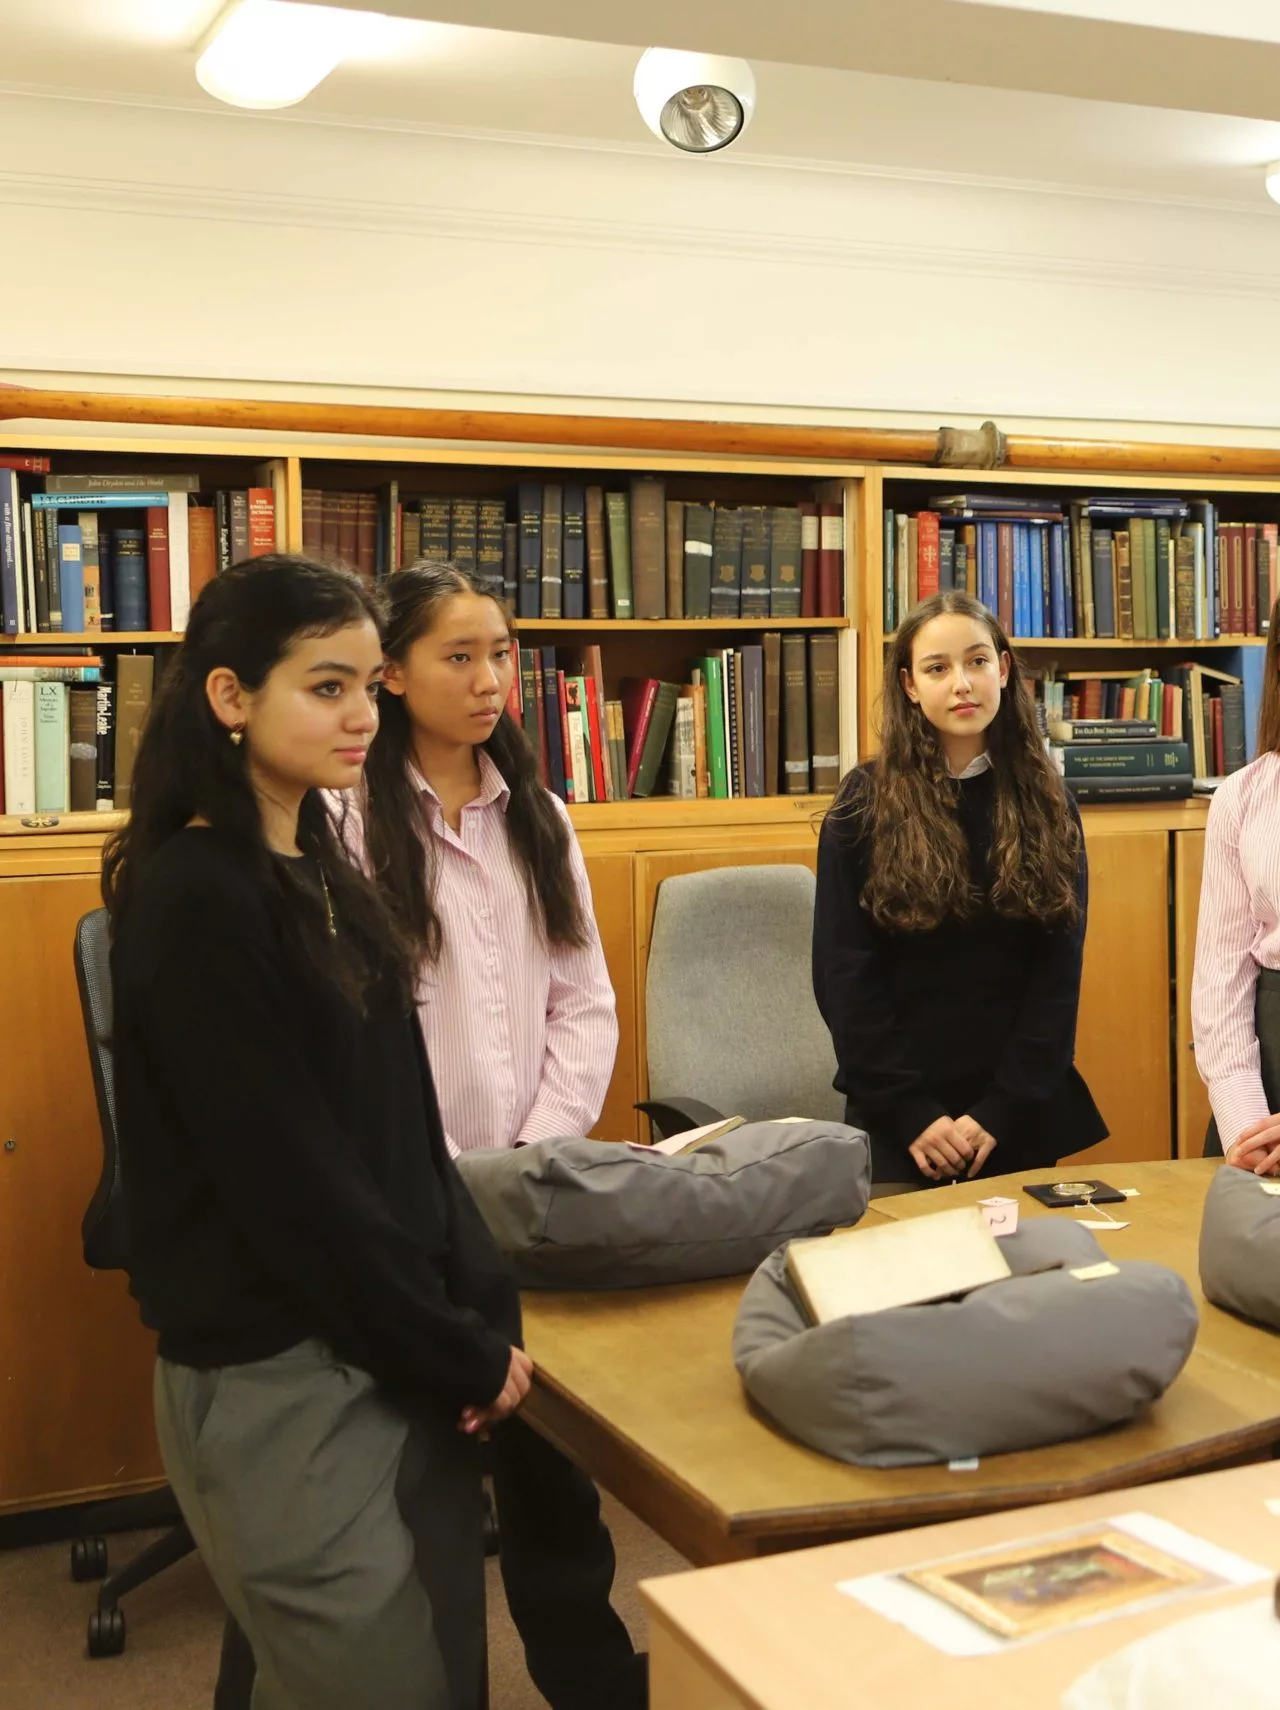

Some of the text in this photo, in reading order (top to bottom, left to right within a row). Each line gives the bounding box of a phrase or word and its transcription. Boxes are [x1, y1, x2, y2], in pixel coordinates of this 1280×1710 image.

[55, 495, 107, 504] CHRISTIE
[221, 528, 229, 555] English
[96, 685, 112, 736] Martin-Leake
